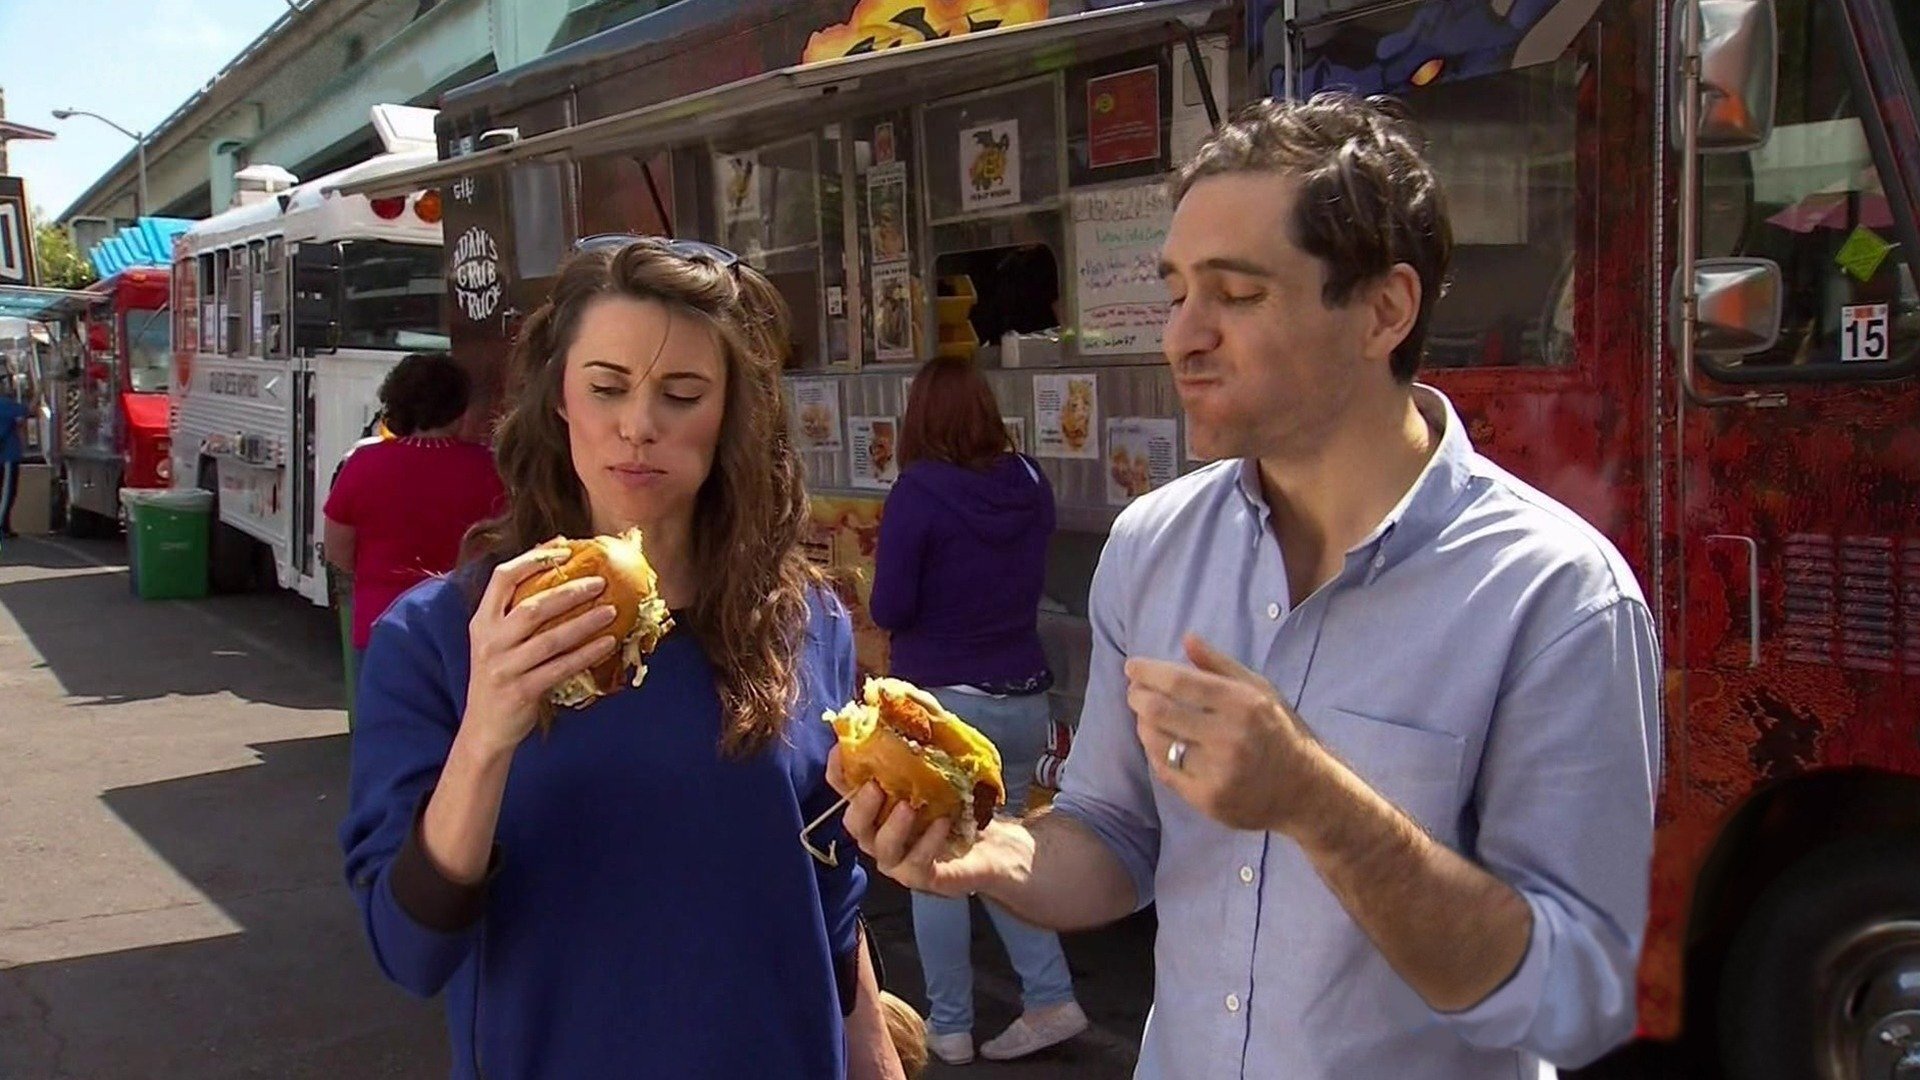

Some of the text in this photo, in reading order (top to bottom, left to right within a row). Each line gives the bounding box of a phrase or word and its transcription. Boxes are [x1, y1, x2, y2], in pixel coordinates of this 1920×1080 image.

[453, 226, 499, 269] ADAM'S
[457, 260, 497, 289] GRUB
[455, 283, 501, 321] TRUCK
[1845, 318, 1885, 358] 15
